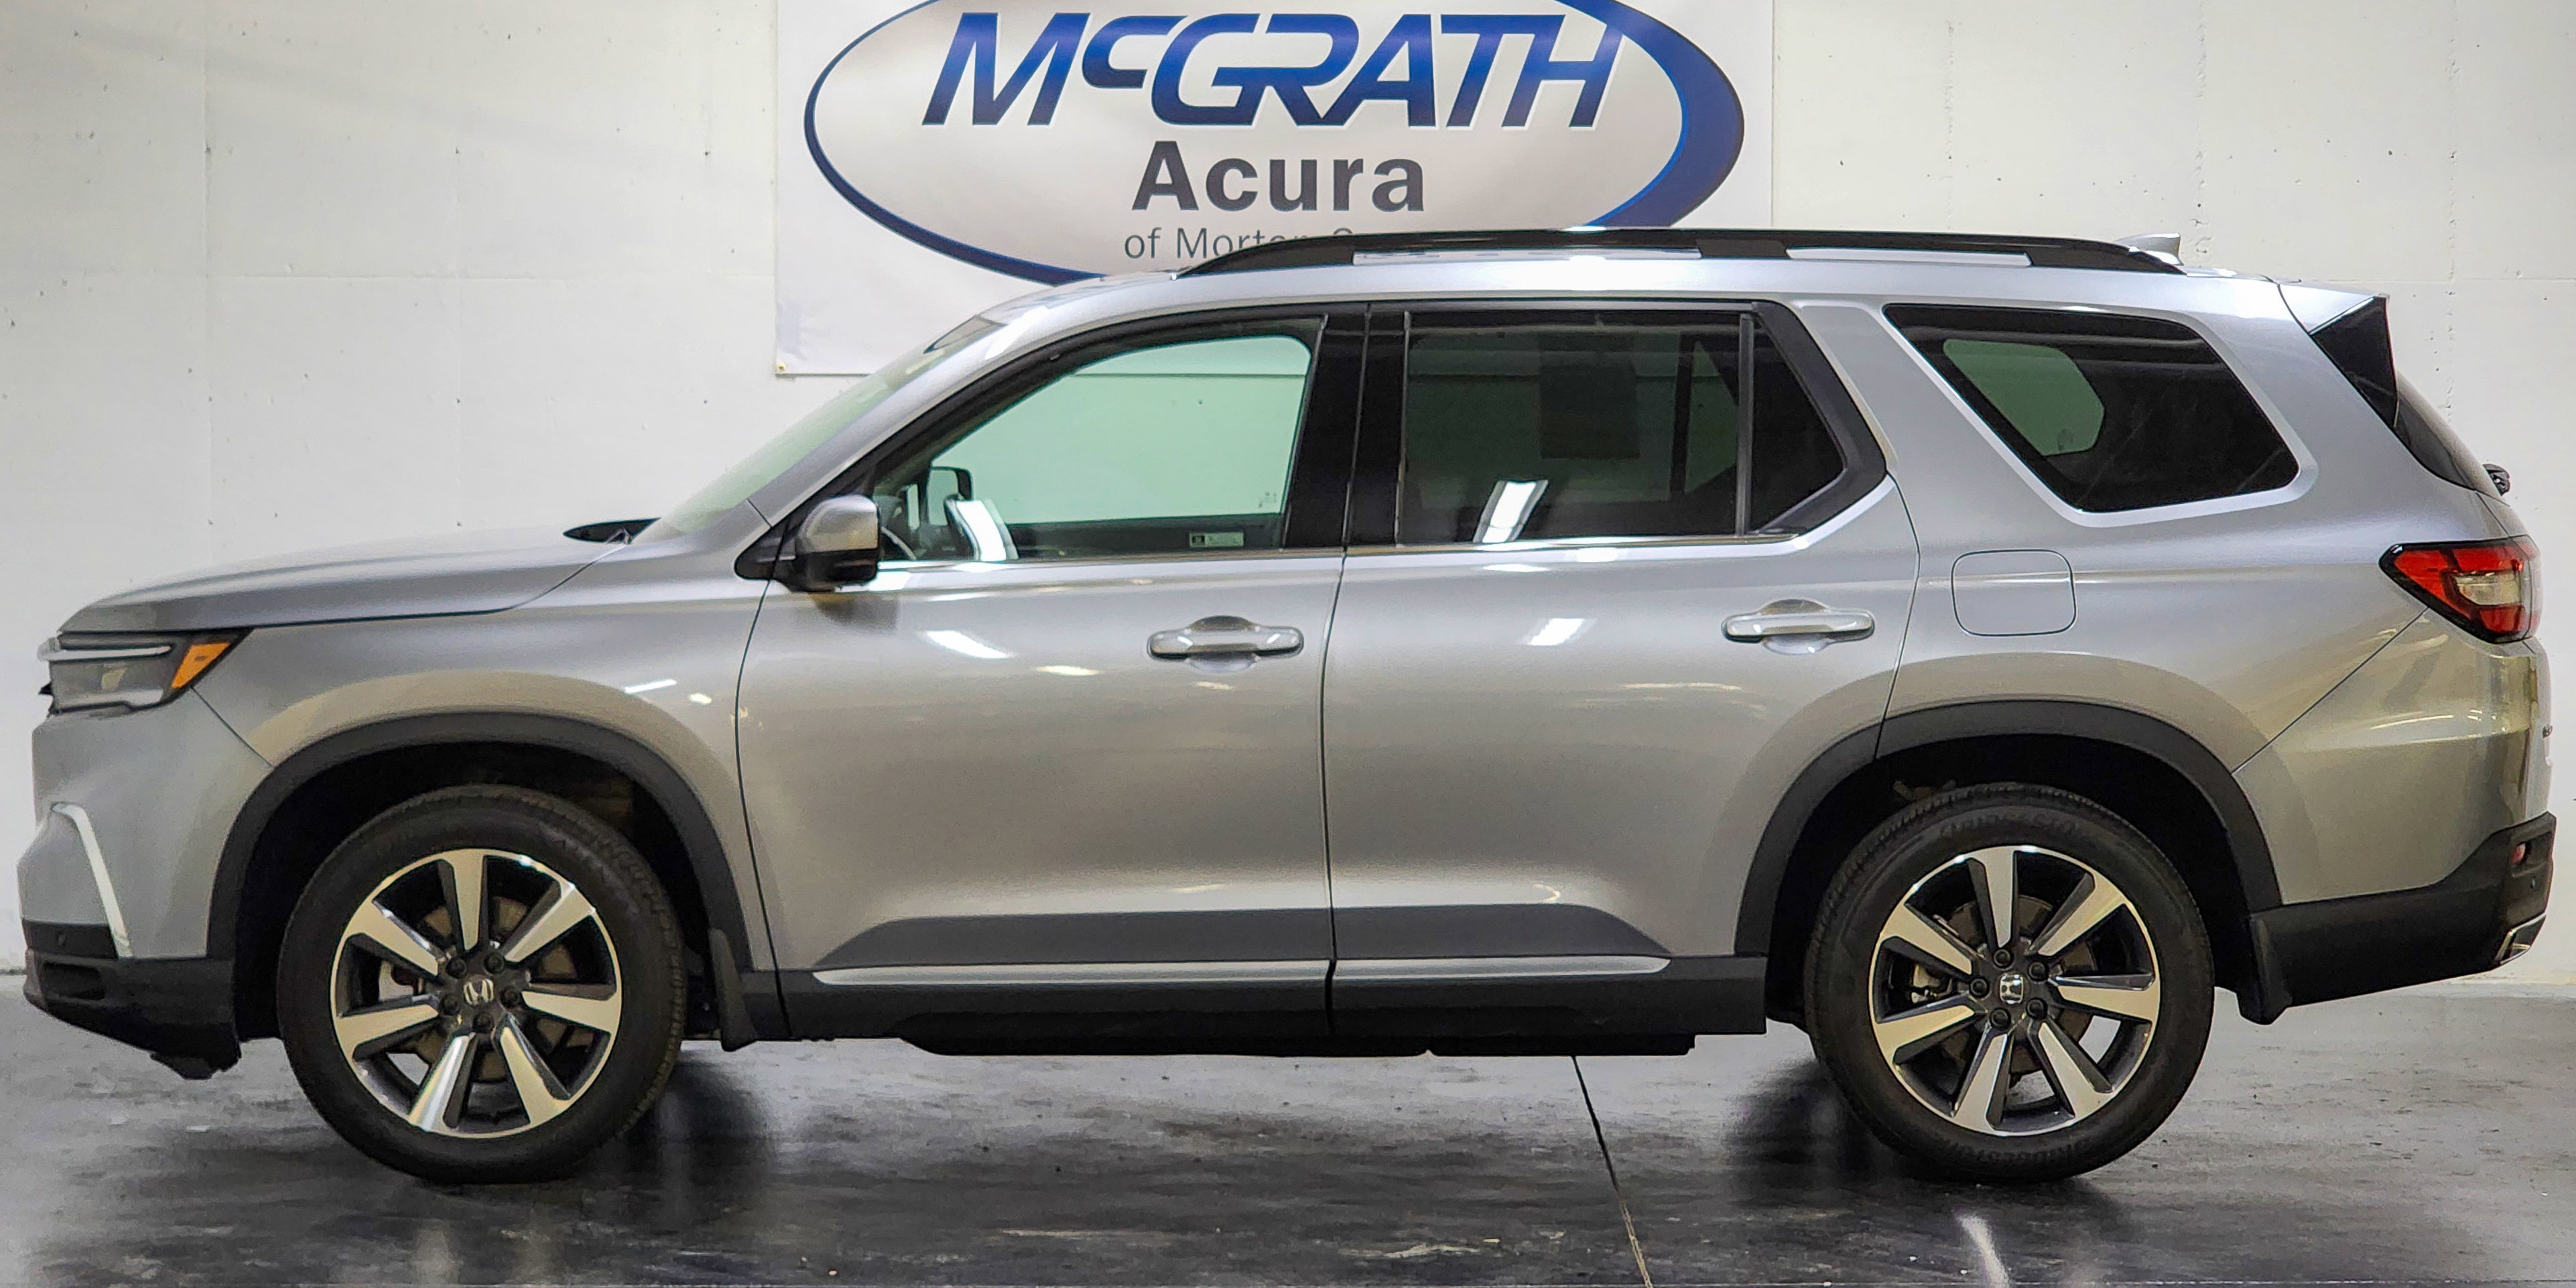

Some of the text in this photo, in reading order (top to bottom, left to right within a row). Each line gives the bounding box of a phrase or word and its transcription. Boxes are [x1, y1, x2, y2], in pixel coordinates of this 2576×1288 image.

[1131, 140, 1424, 212] Acura
[1124, 227, 1308, 258] of Mort
